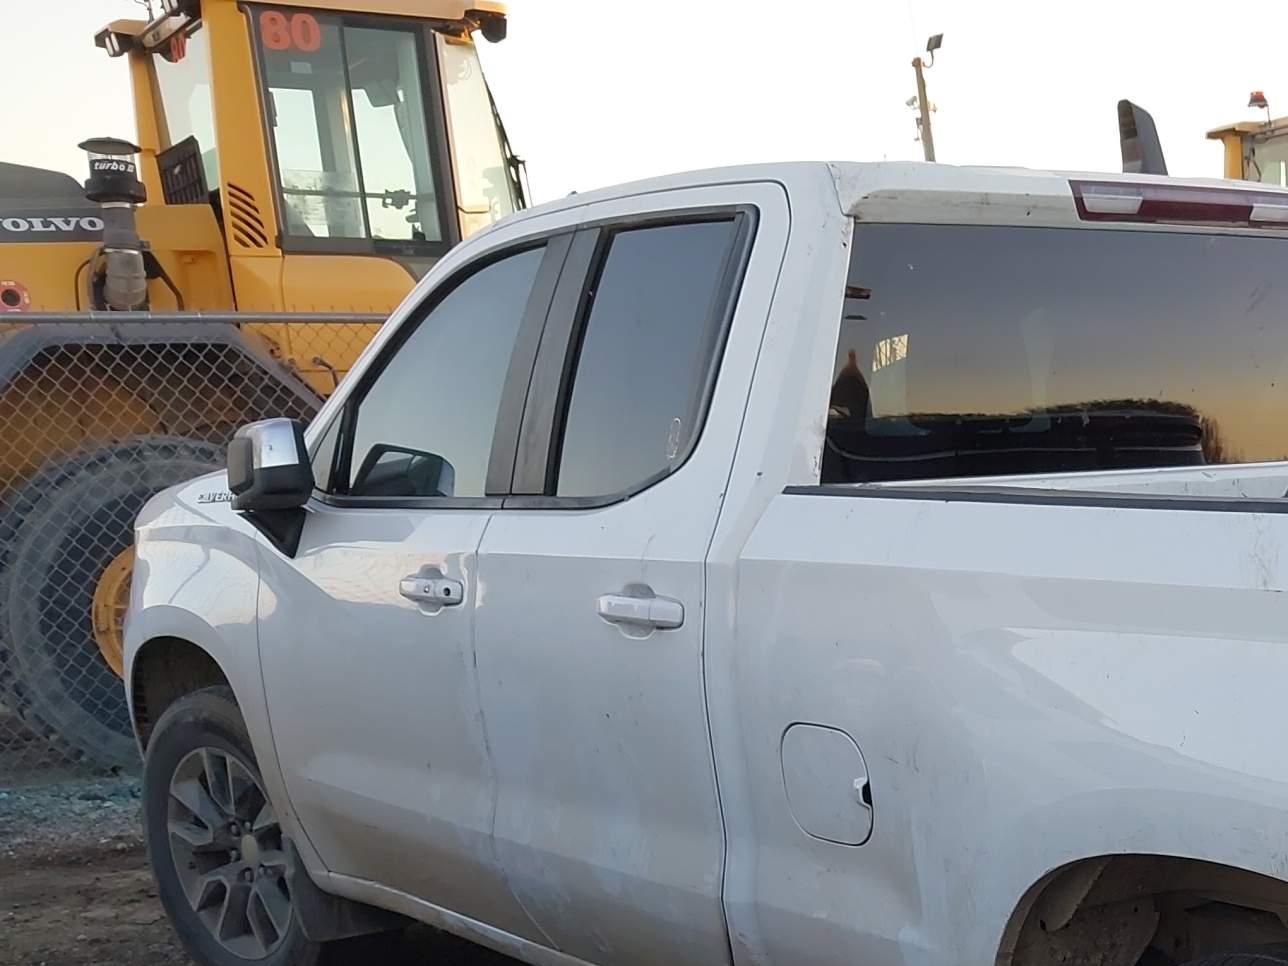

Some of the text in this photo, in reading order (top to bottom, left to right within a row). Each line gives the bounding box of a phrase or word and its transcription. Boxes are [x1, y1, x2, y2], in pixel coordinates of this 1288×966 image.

[259, 10, 320, 51] 80
[94, 161, 126, 171] turbo
[0, 217, 105, 232] OLVO
